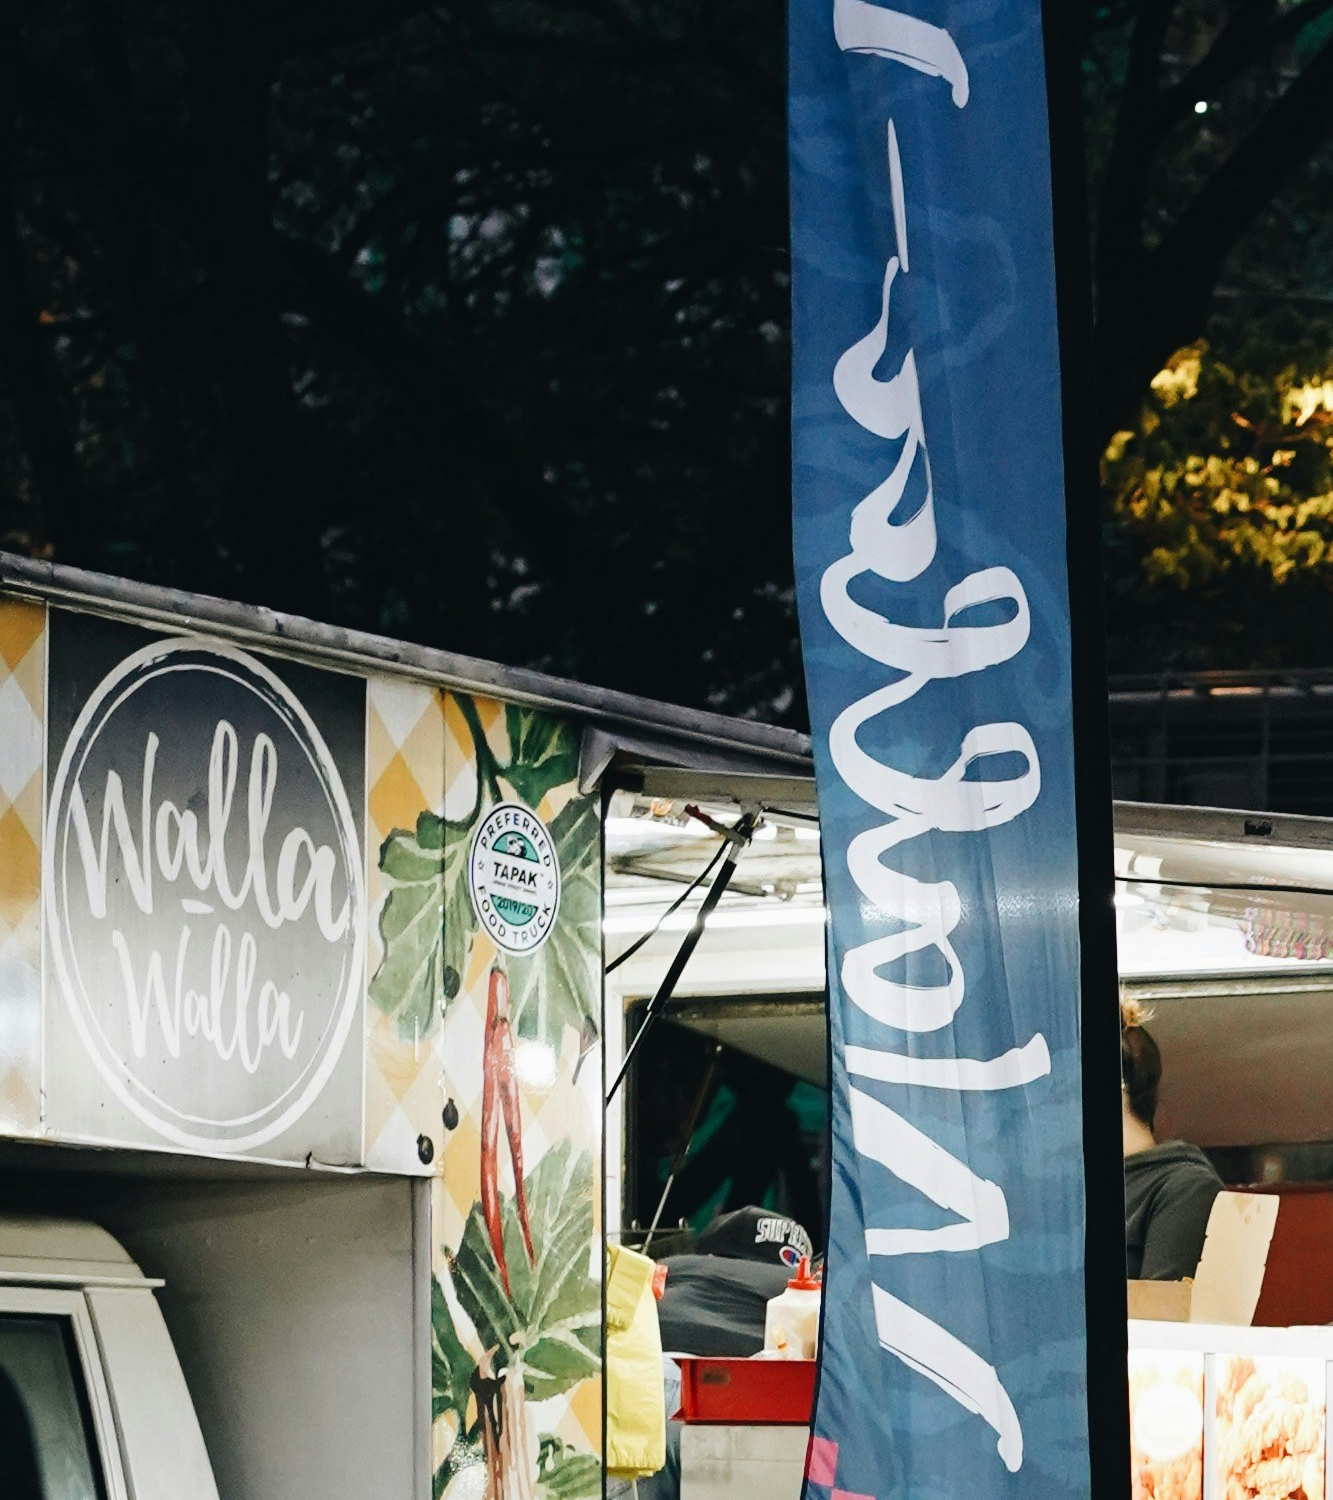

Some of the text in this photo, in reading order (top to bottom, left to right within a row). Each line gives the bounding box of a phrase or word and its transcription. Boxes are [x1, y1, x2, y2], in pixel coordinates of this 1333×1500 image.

[71, 719, 352, 943] Walla
[480, 812, 552, 867] PREFERRED
[493, 861, 538, 888] TAPAK
[478, 885, 552, 945] FOOD TRUCK
[112, 922, 304, 1074] Walla
